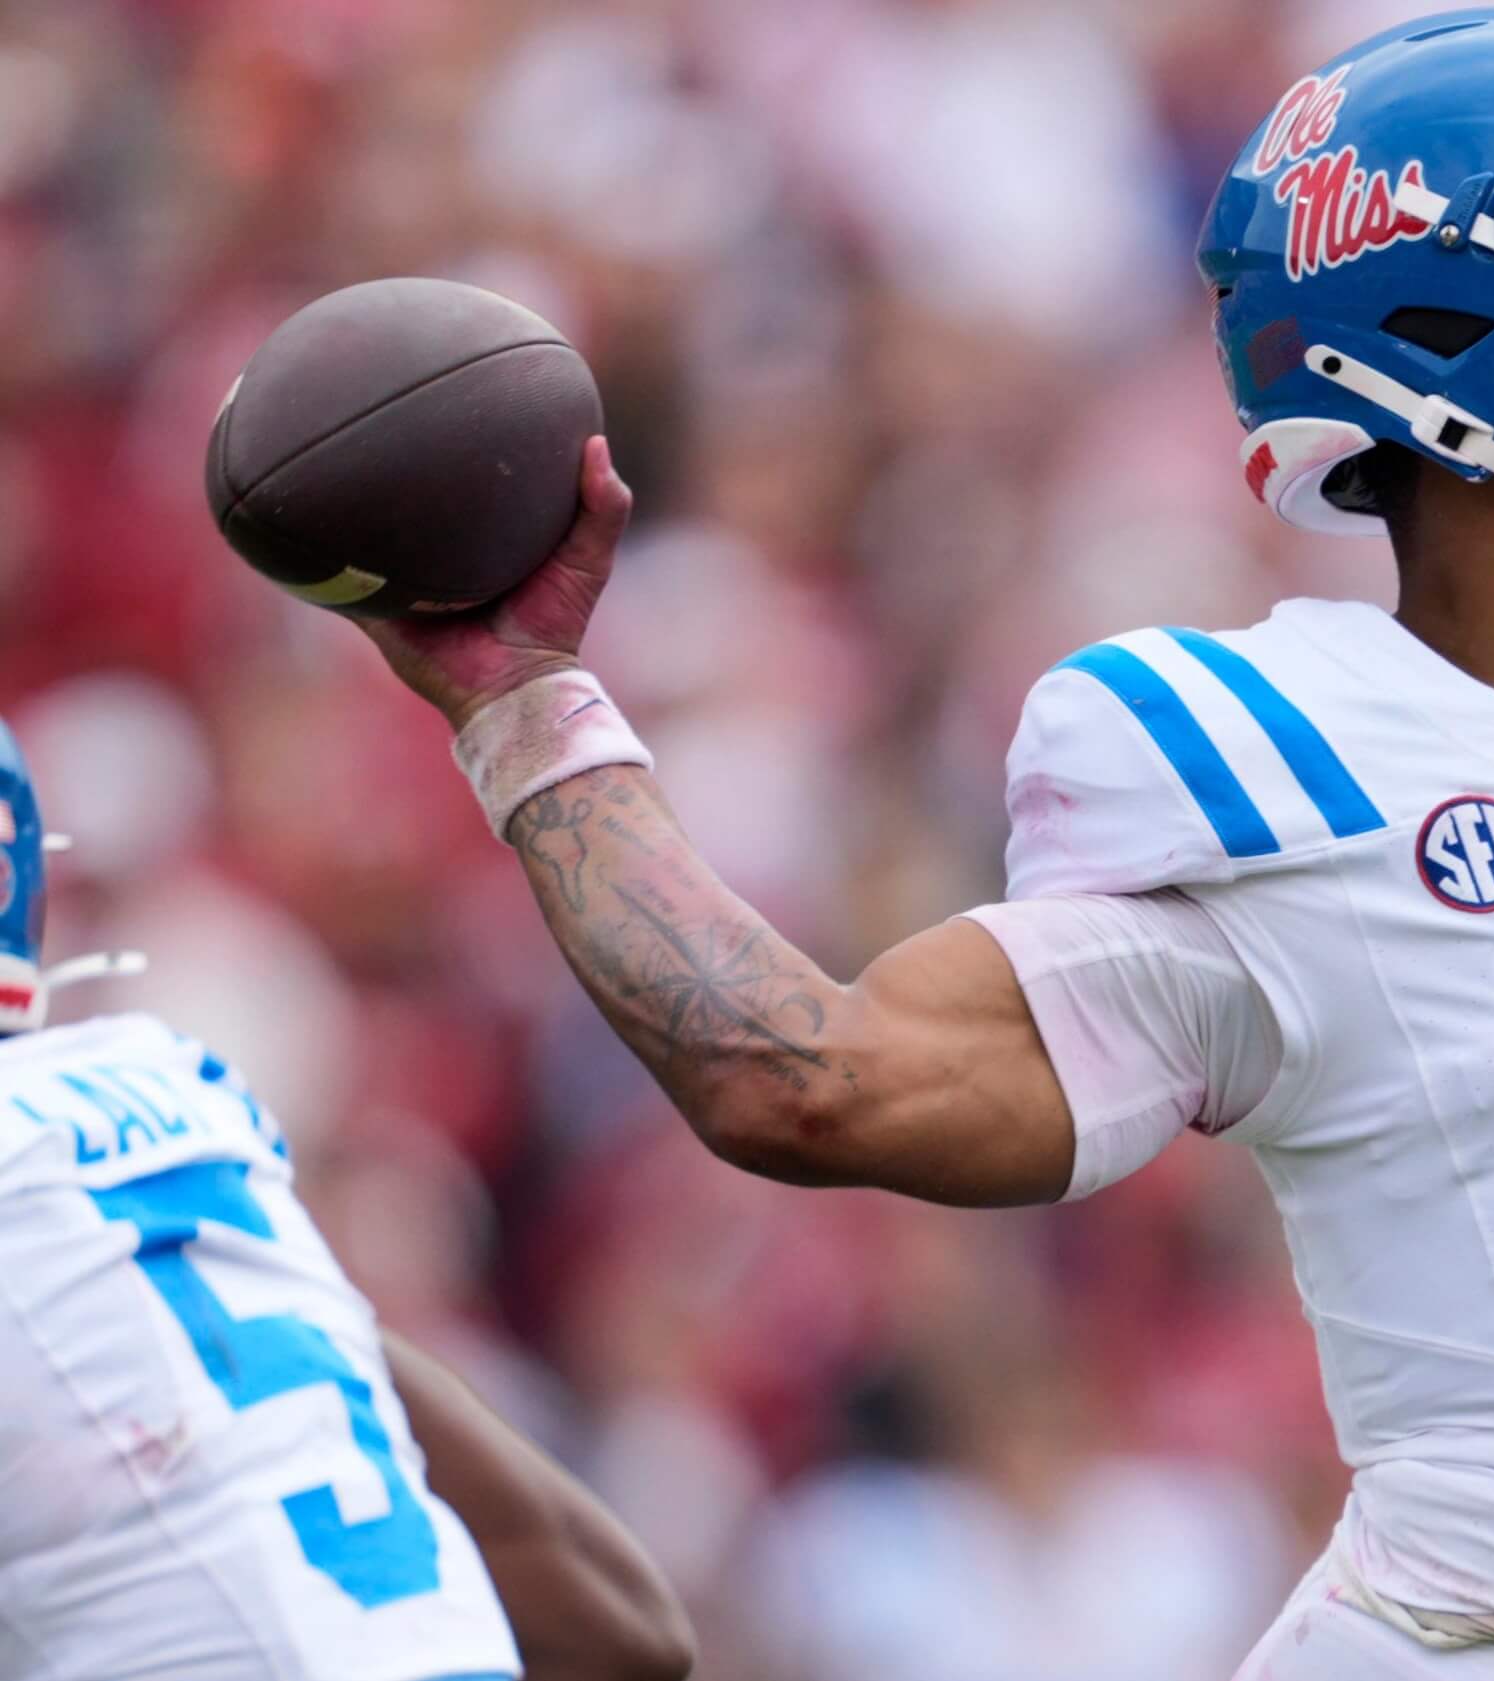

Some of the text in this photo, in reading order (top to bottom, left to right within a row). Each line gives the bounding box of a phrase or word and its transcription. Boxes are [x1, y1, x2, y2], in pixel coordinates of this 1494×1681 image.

[1253, 63, 1352, 175] Ole
[11, 1064, 212, 1165] LAC
[88, 1160, 441, 1610] 5
